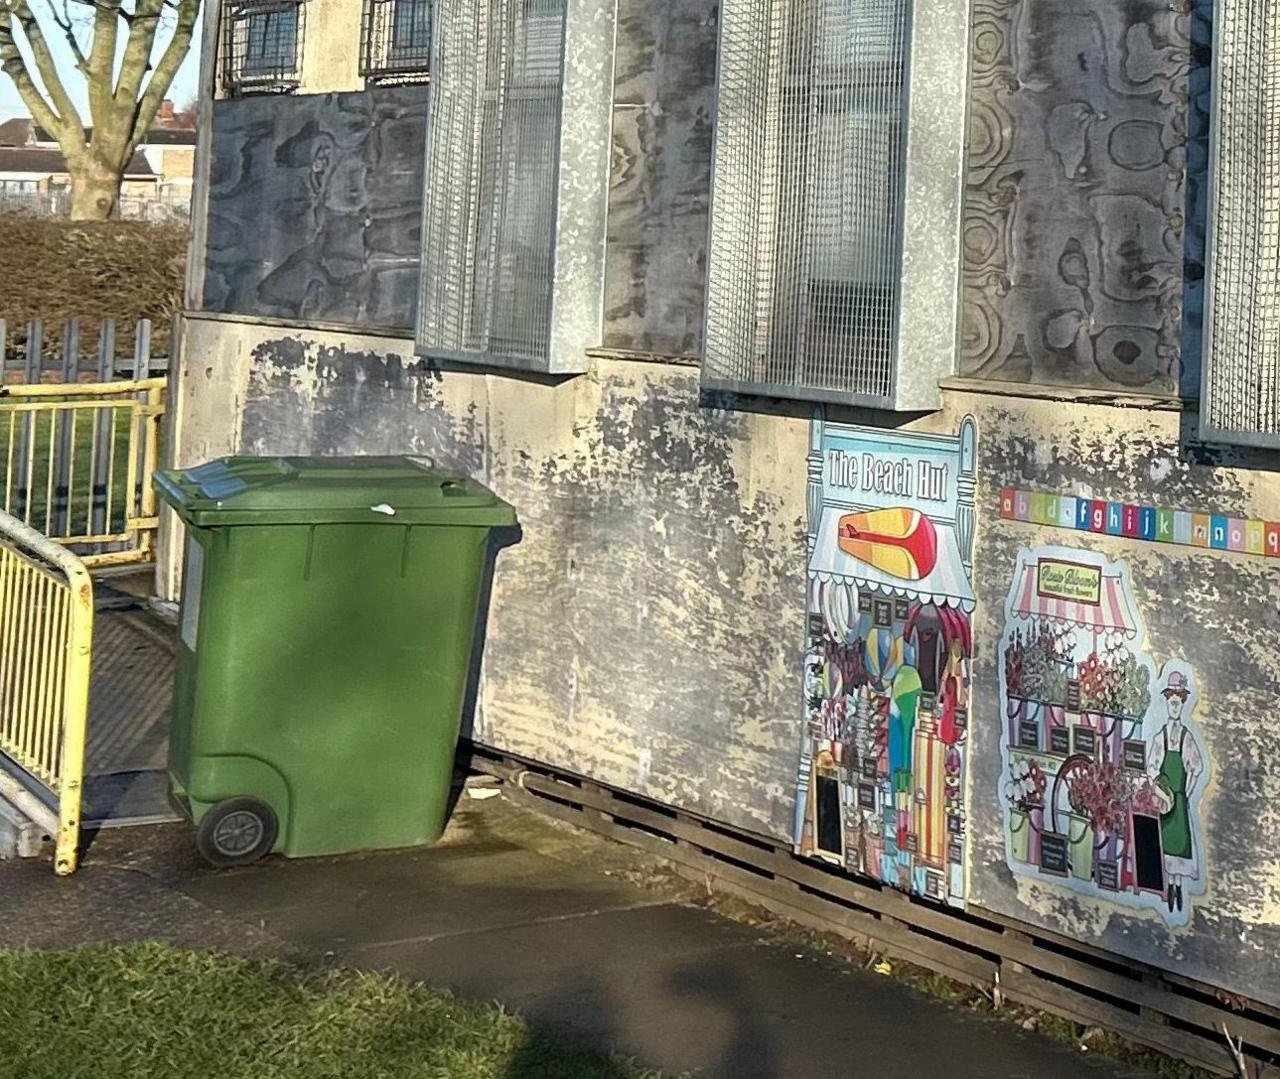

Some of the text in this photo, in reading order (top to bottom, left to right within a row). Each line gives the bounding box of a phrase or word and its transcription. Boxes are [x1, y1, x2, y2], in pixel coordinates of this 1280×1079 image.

[829, 449, 948, 502] The Beach Hut
